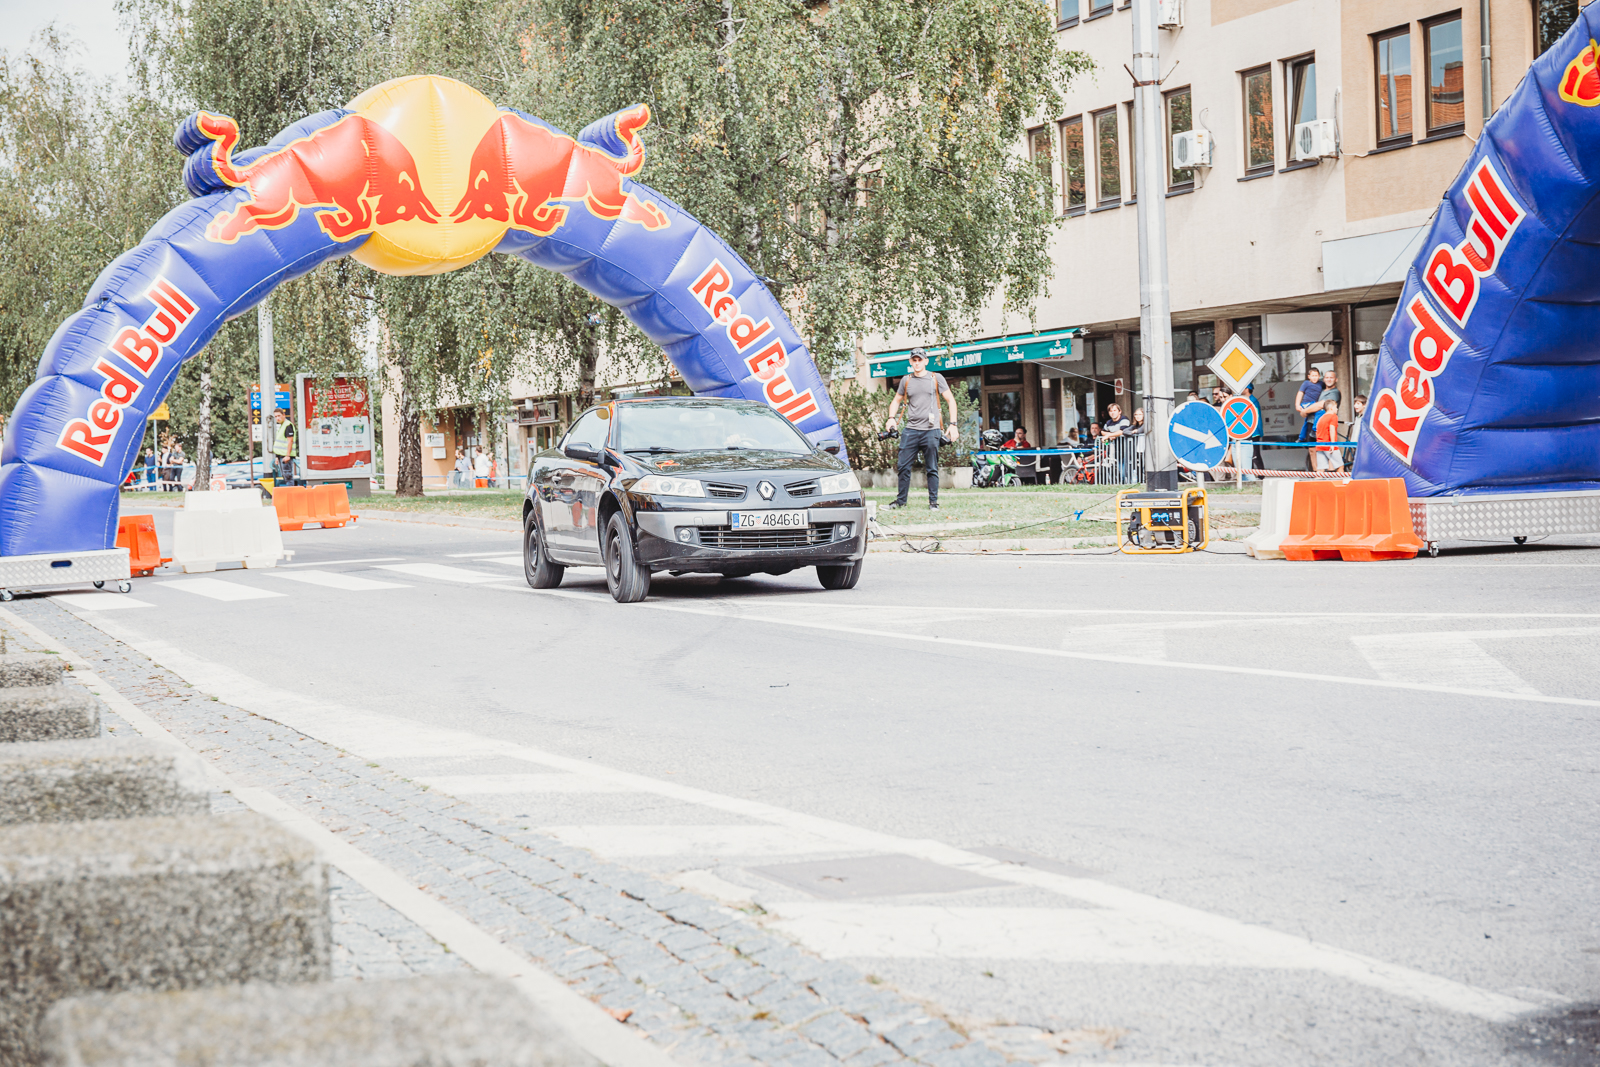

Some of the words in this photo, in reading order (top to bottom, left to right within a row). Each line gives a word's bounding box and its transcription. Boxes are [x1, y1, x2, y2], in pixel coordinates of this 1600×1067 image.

[59, 358, 142, 463] Red
[110, 277, 197, 375] Bull
[690, 261, 773, 351] Red
[746, 339, 818, 424] Bull
[1370, 296, 1456, 461] Red
[1424, 162, 1521, 323] Bull
[740, 514, 755, 527] ZG
